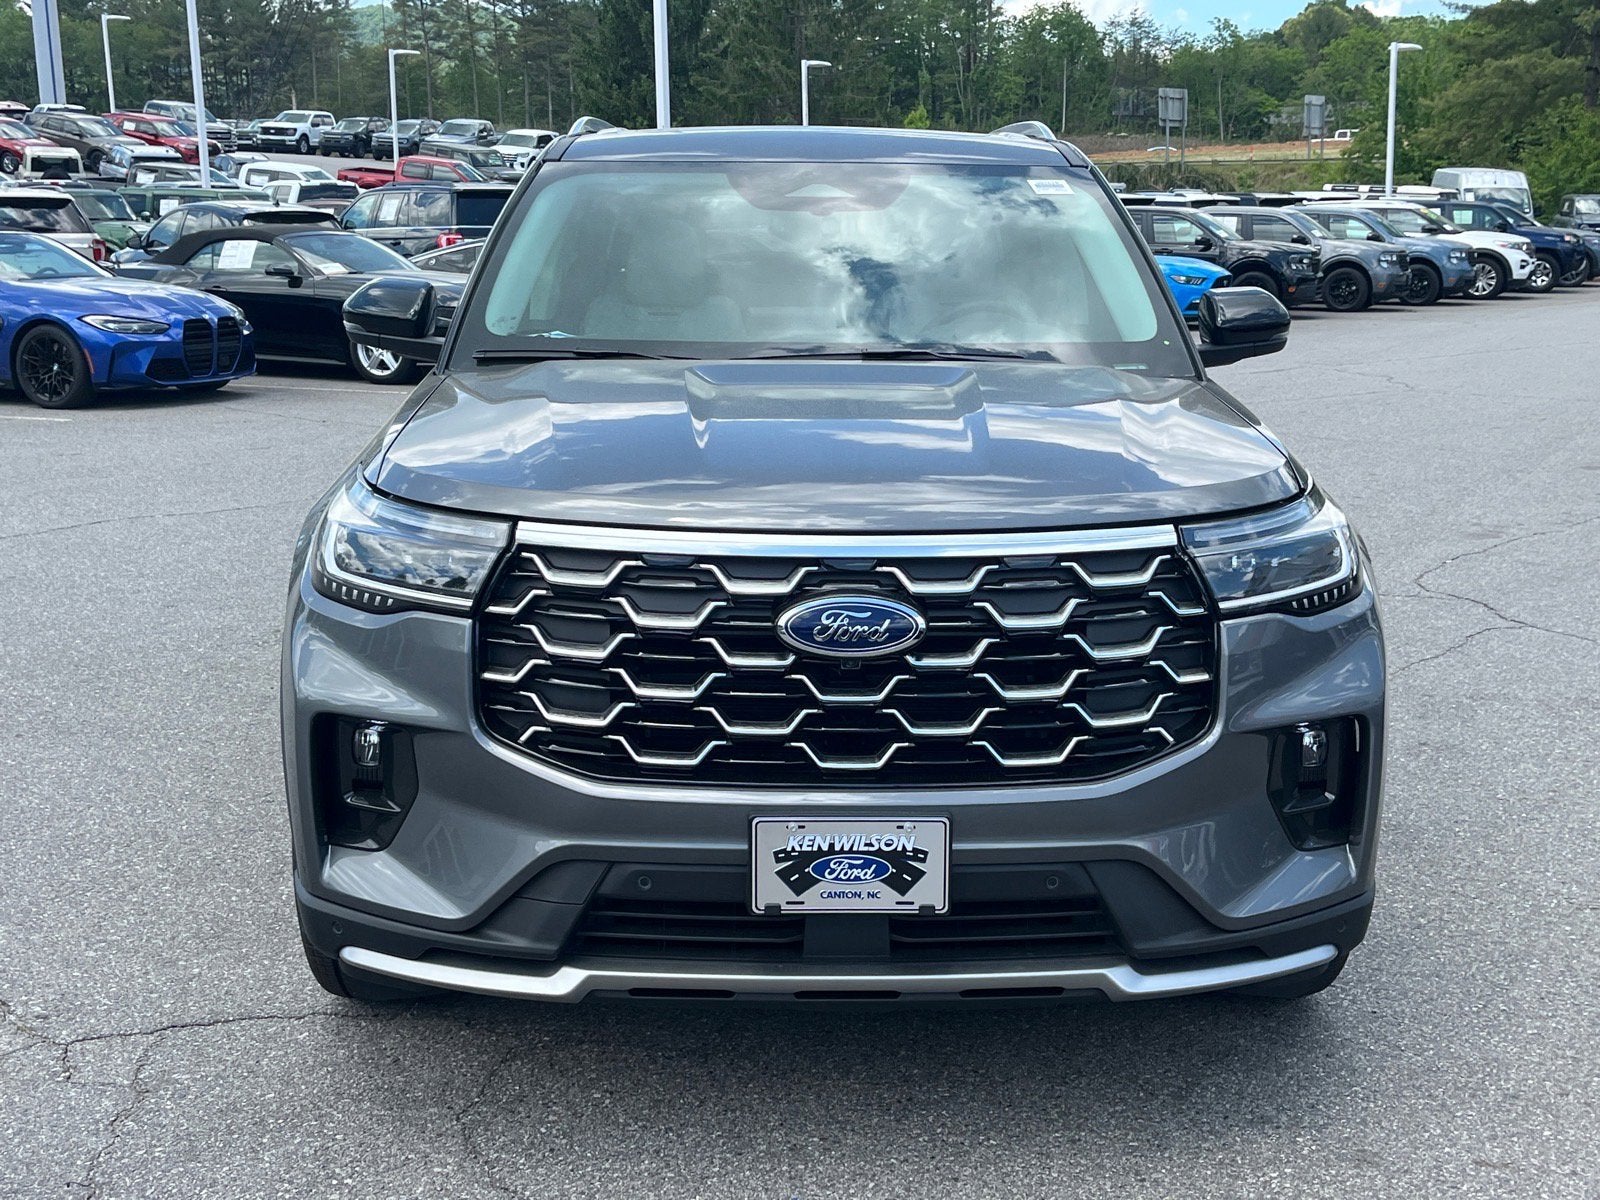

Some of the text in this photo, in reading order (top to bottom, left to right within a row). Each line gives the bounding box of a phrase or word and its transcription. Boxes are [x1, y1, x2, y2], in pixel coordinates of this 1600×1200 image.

[812, 609, 891, 642] Ford
[786, 833, 917, 852] KEN WILSON
[824, 858, 877, 880] Ford
[820, 890, 881, 900] CANTON, NC
